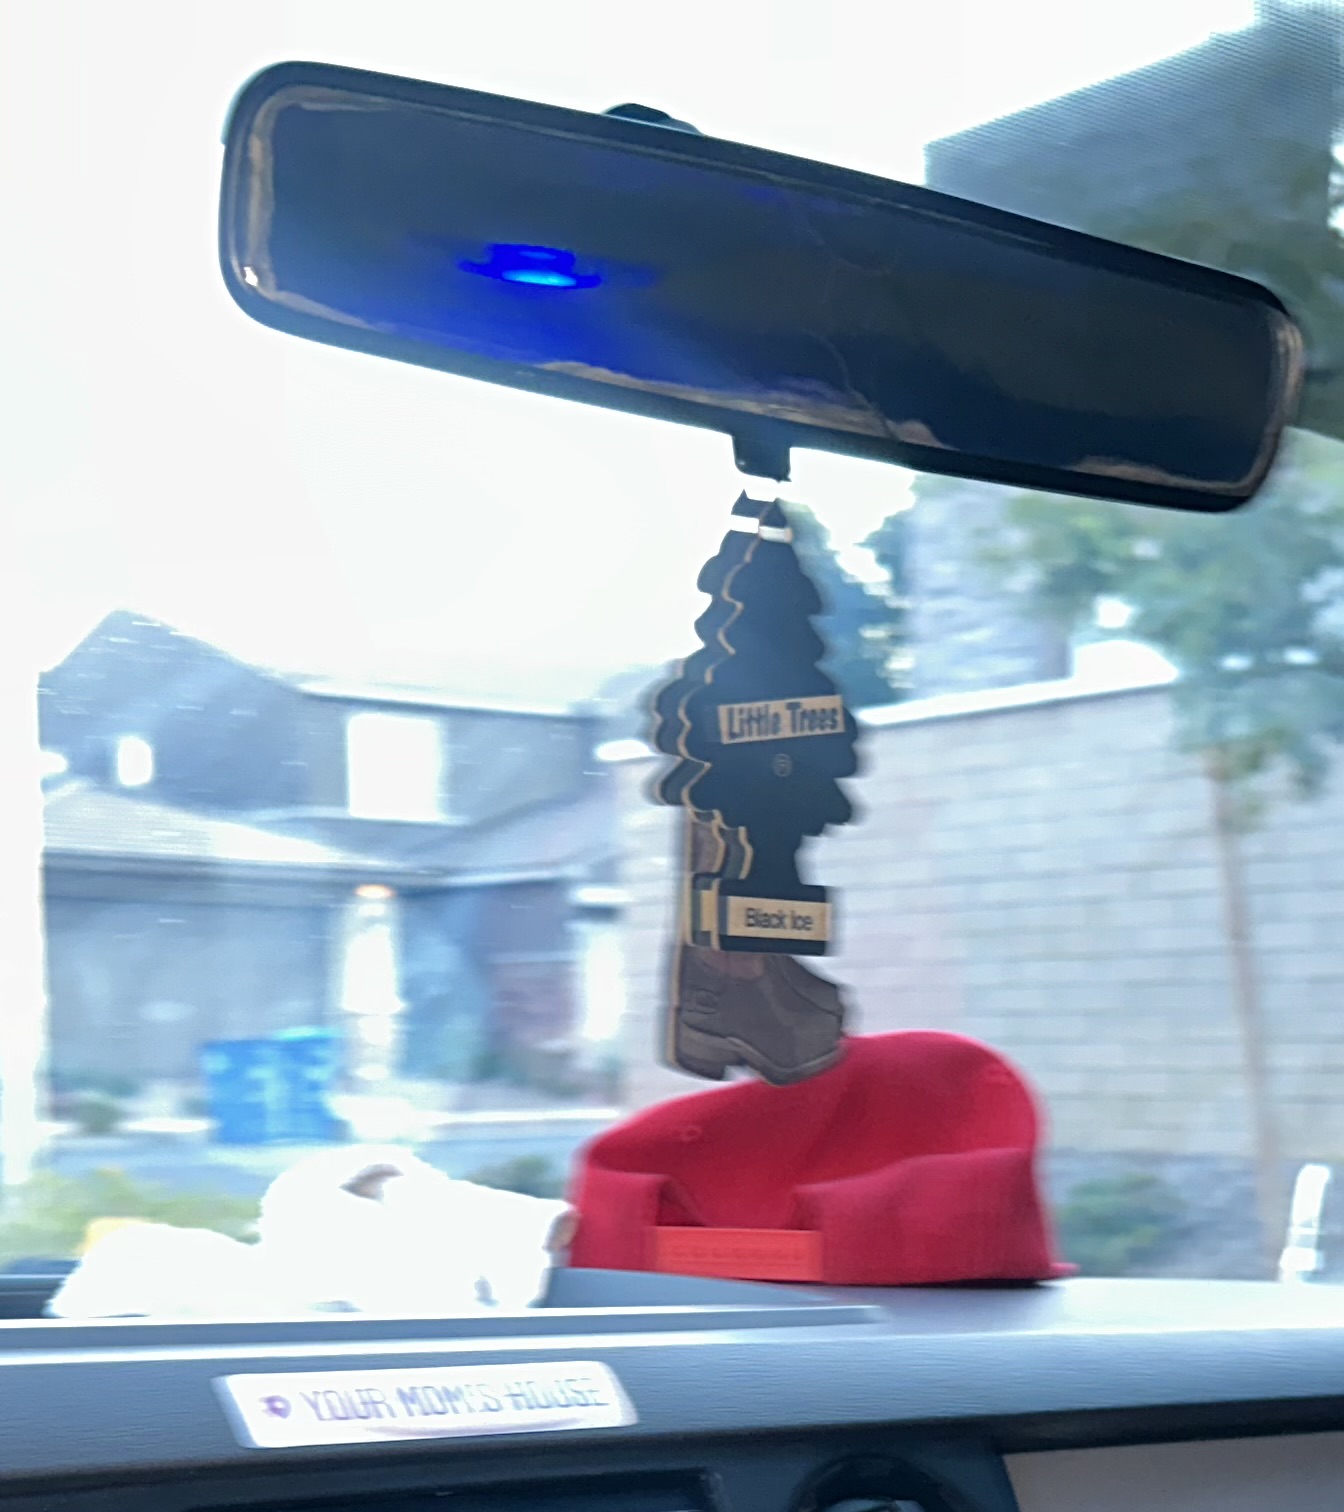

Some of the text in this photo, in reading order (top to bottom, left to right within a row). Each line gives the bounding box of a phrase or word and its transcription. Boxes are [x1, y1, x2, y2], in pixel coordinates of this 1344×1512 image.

[726, 700, 839, 740] Little Trees
[745, 906, 814, 932] Black Ice
[299, 1387, 397, 1422] YOUR
[503, 1377, 610, 1411] HOUSE
